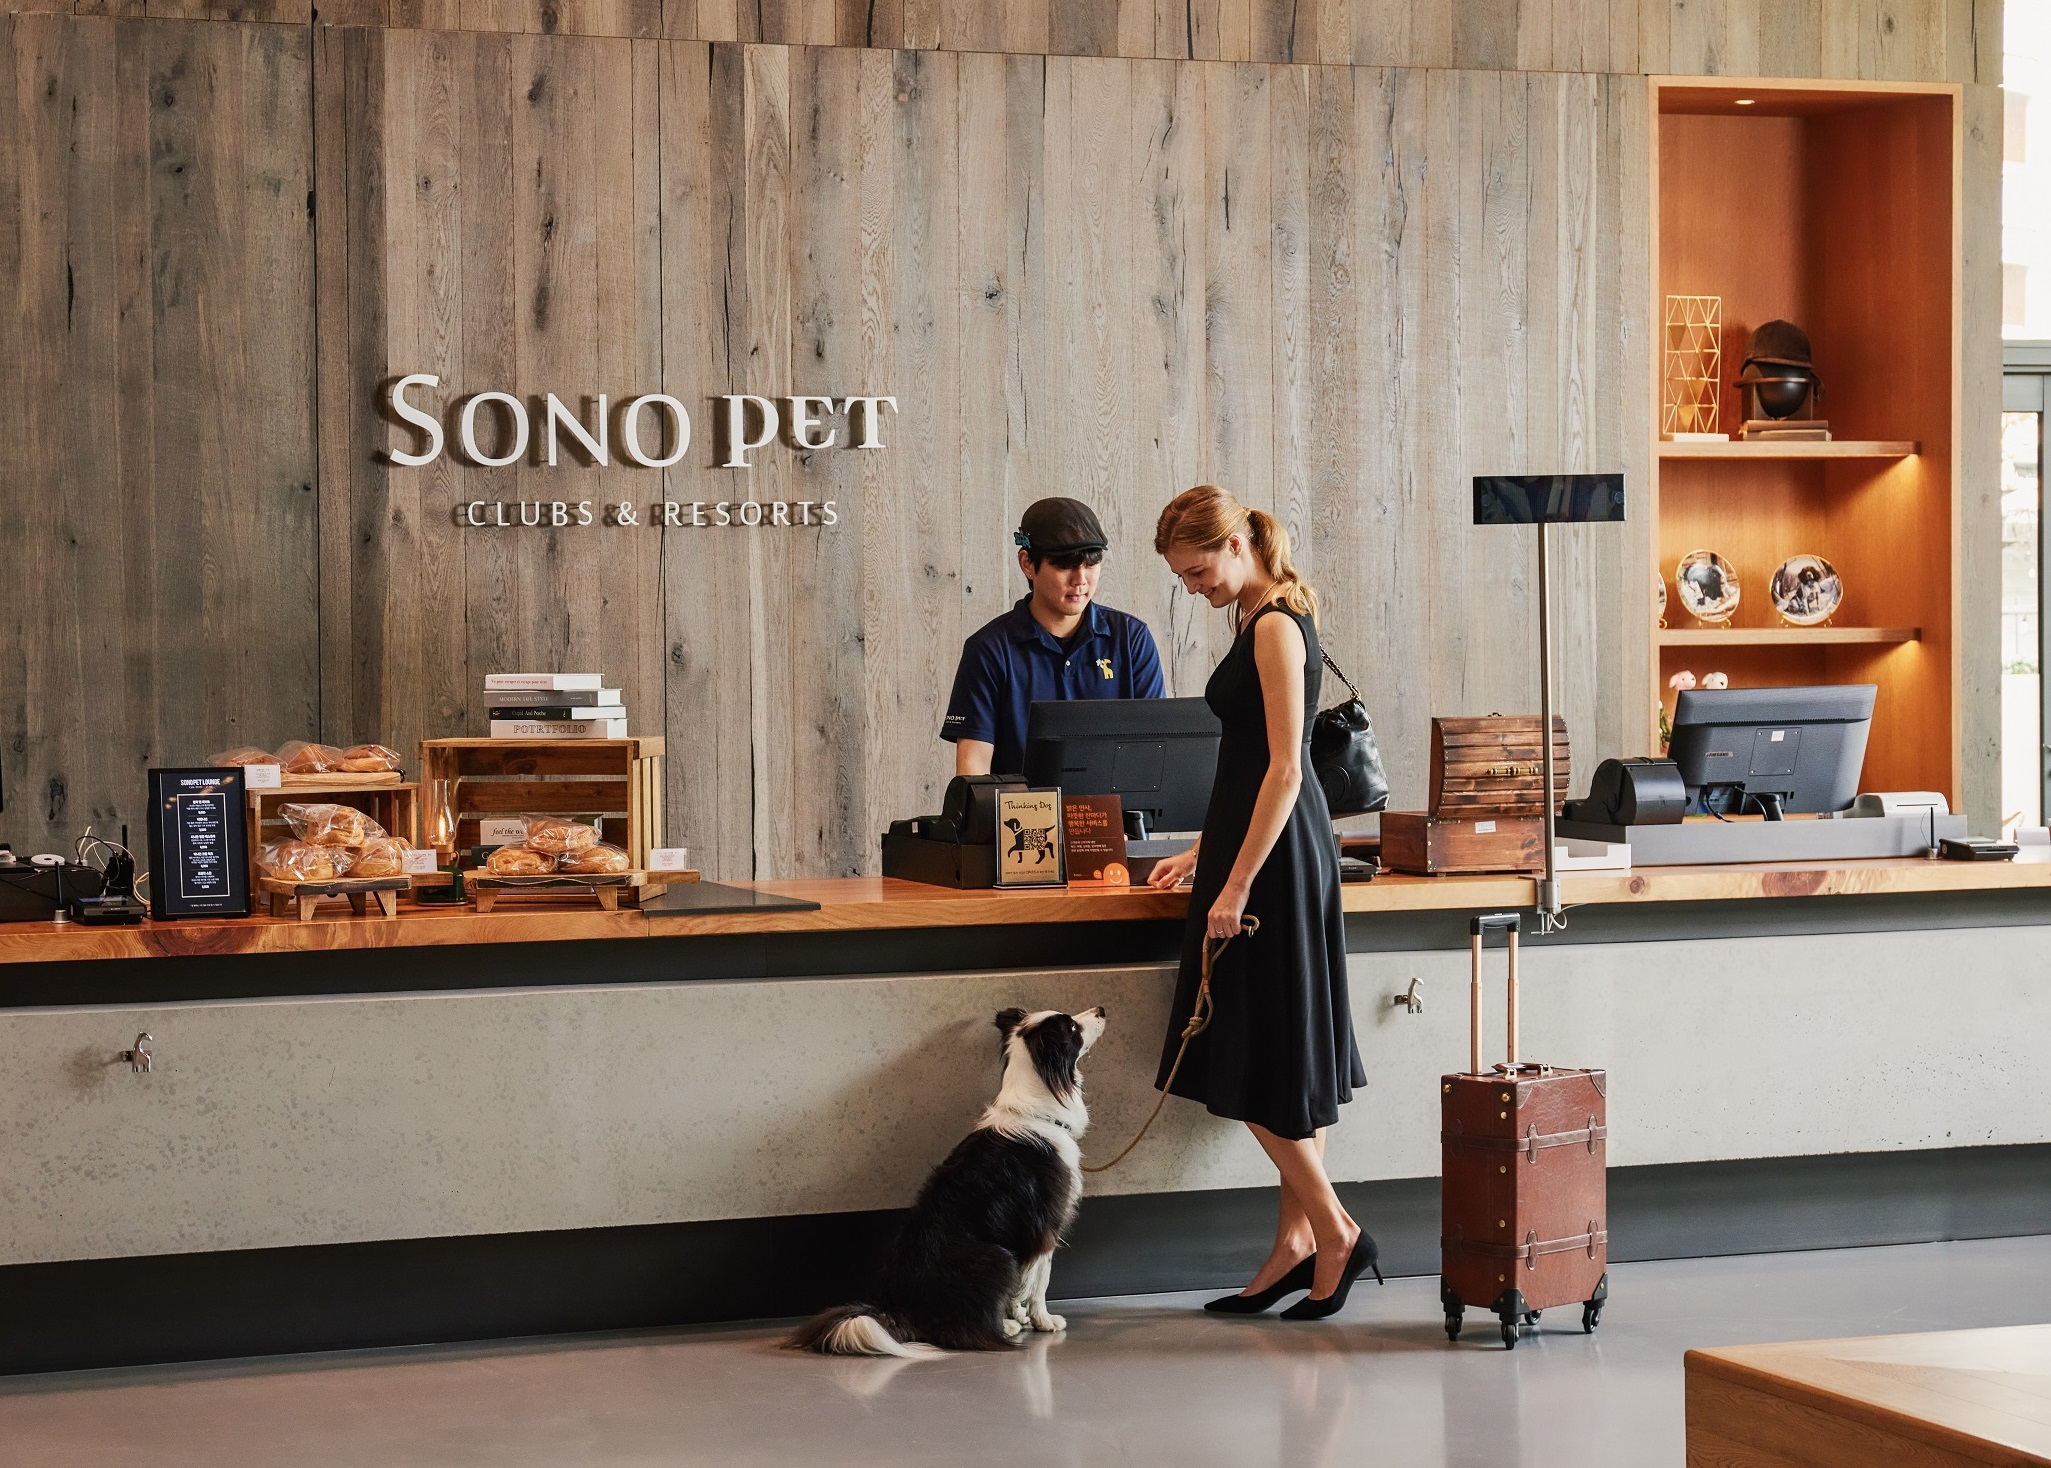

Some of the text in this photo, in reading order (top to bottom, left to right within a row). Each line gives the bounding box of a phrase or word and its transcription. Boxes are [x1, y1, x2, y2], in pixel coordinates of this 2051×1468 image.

[389, 374, 898, 468] SONO PET
[467, 501, 838, 526] CLUBS & RESORTS
[513, 724, 587, 734] POTRTFOLIO
[1004, 800, 1052, 811] Thinking Dog
[491, 827, 505, 837] feel
[504, 827, 514, 835] the
